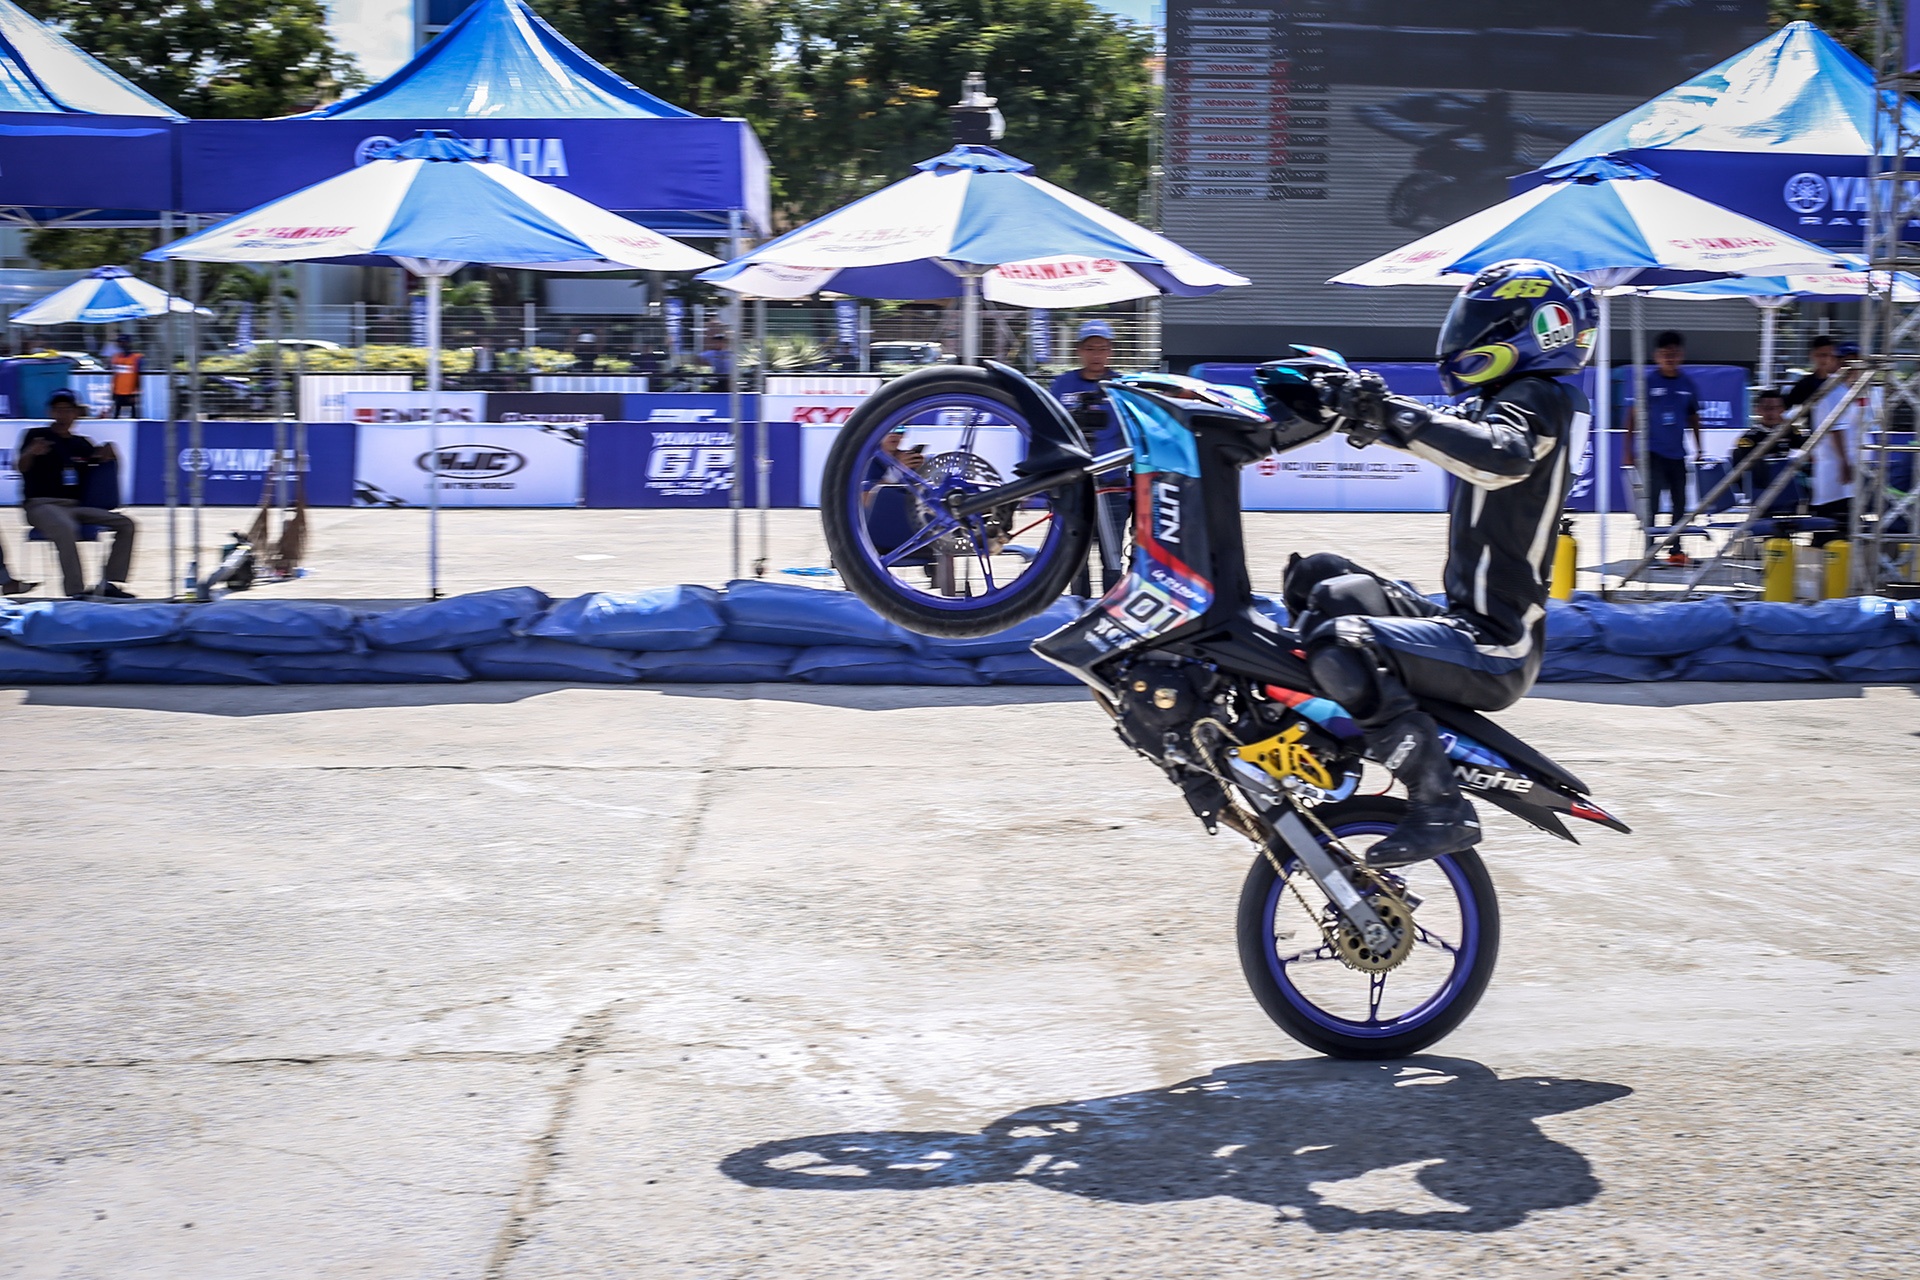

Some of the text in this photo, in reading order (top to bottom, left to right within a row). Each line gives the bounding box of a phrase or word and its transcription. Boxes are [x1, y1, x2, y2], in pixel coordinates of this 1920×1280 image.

[1492, 279, 1553, 299] 46
[433, 452, 508, 470] HJC
[644, 447, 737, 480] GP
[1158, 482, 1180, 544] UTN
[1453, 764, 1535, 794] Nghe
